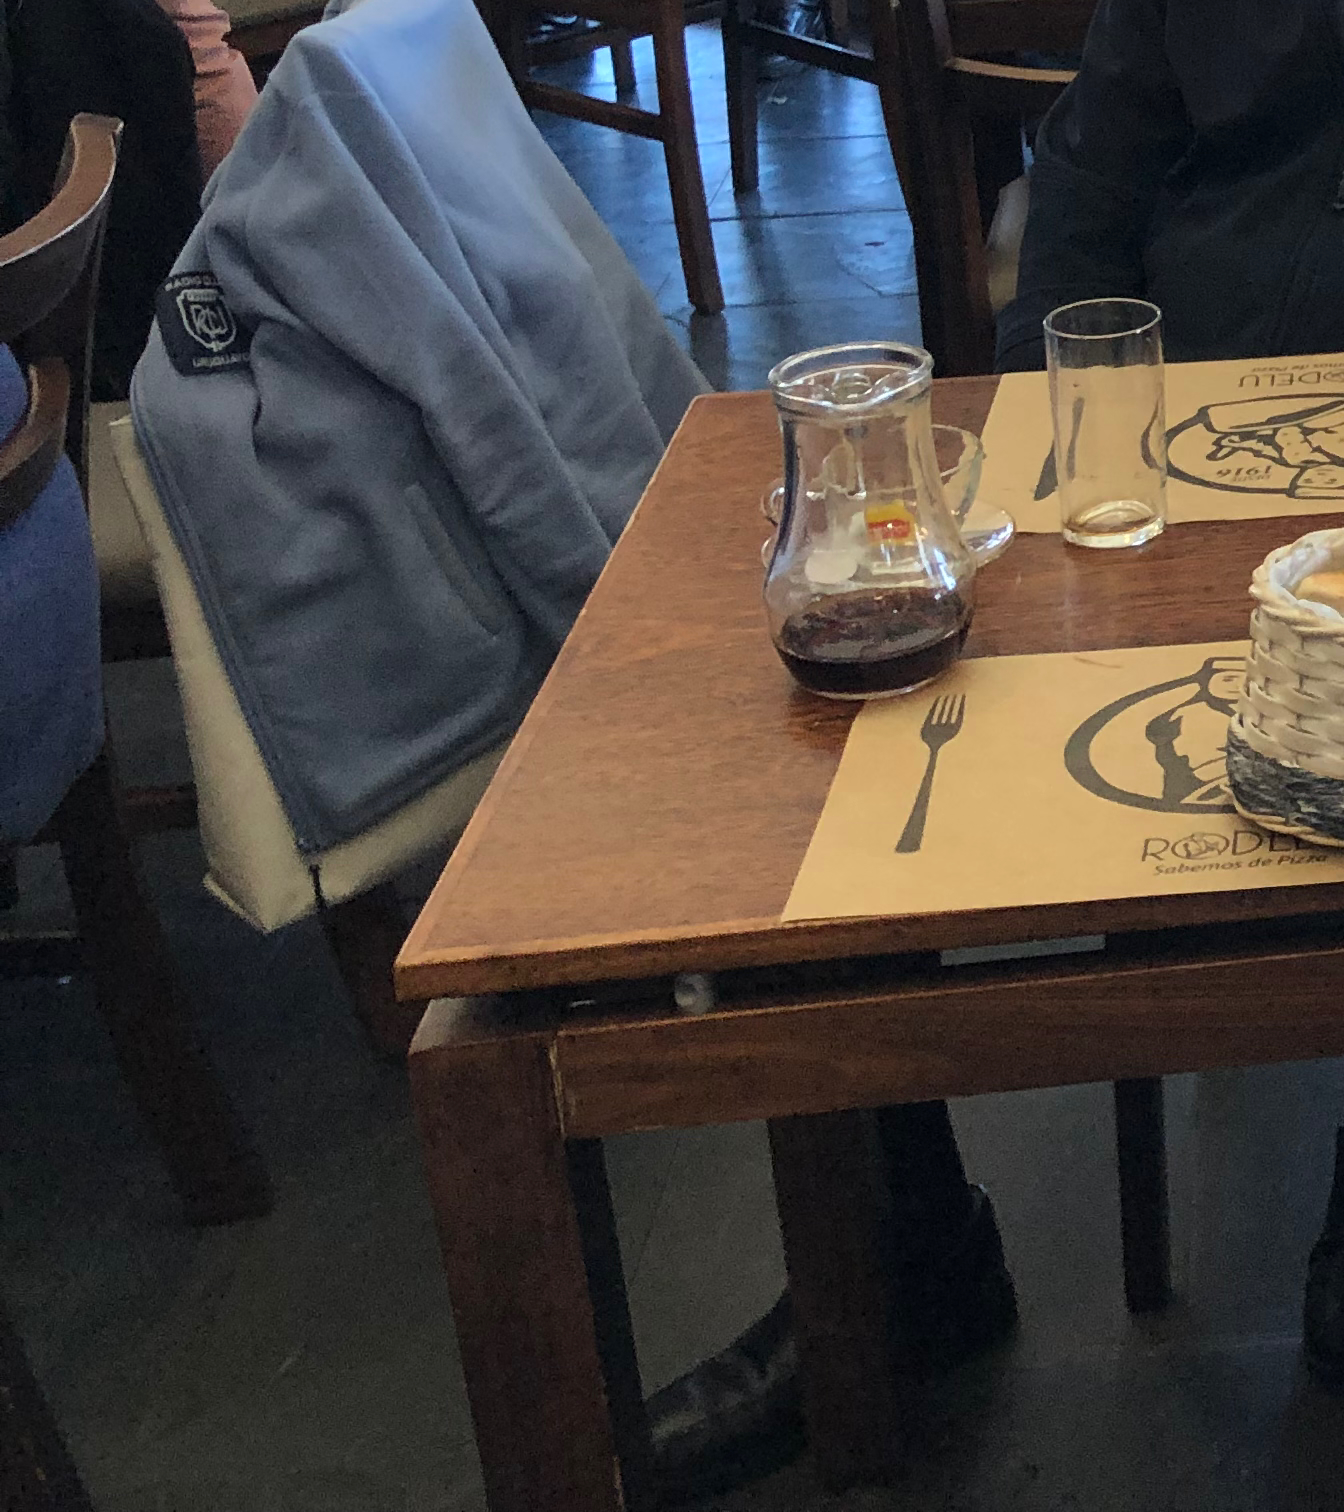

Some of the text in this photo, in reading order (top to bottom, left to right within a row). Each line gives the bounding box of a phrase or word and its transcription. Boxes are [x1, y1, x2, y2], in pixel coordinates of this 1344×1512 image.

[1153, 853, 1328, 875] Sabemos de Pizza
